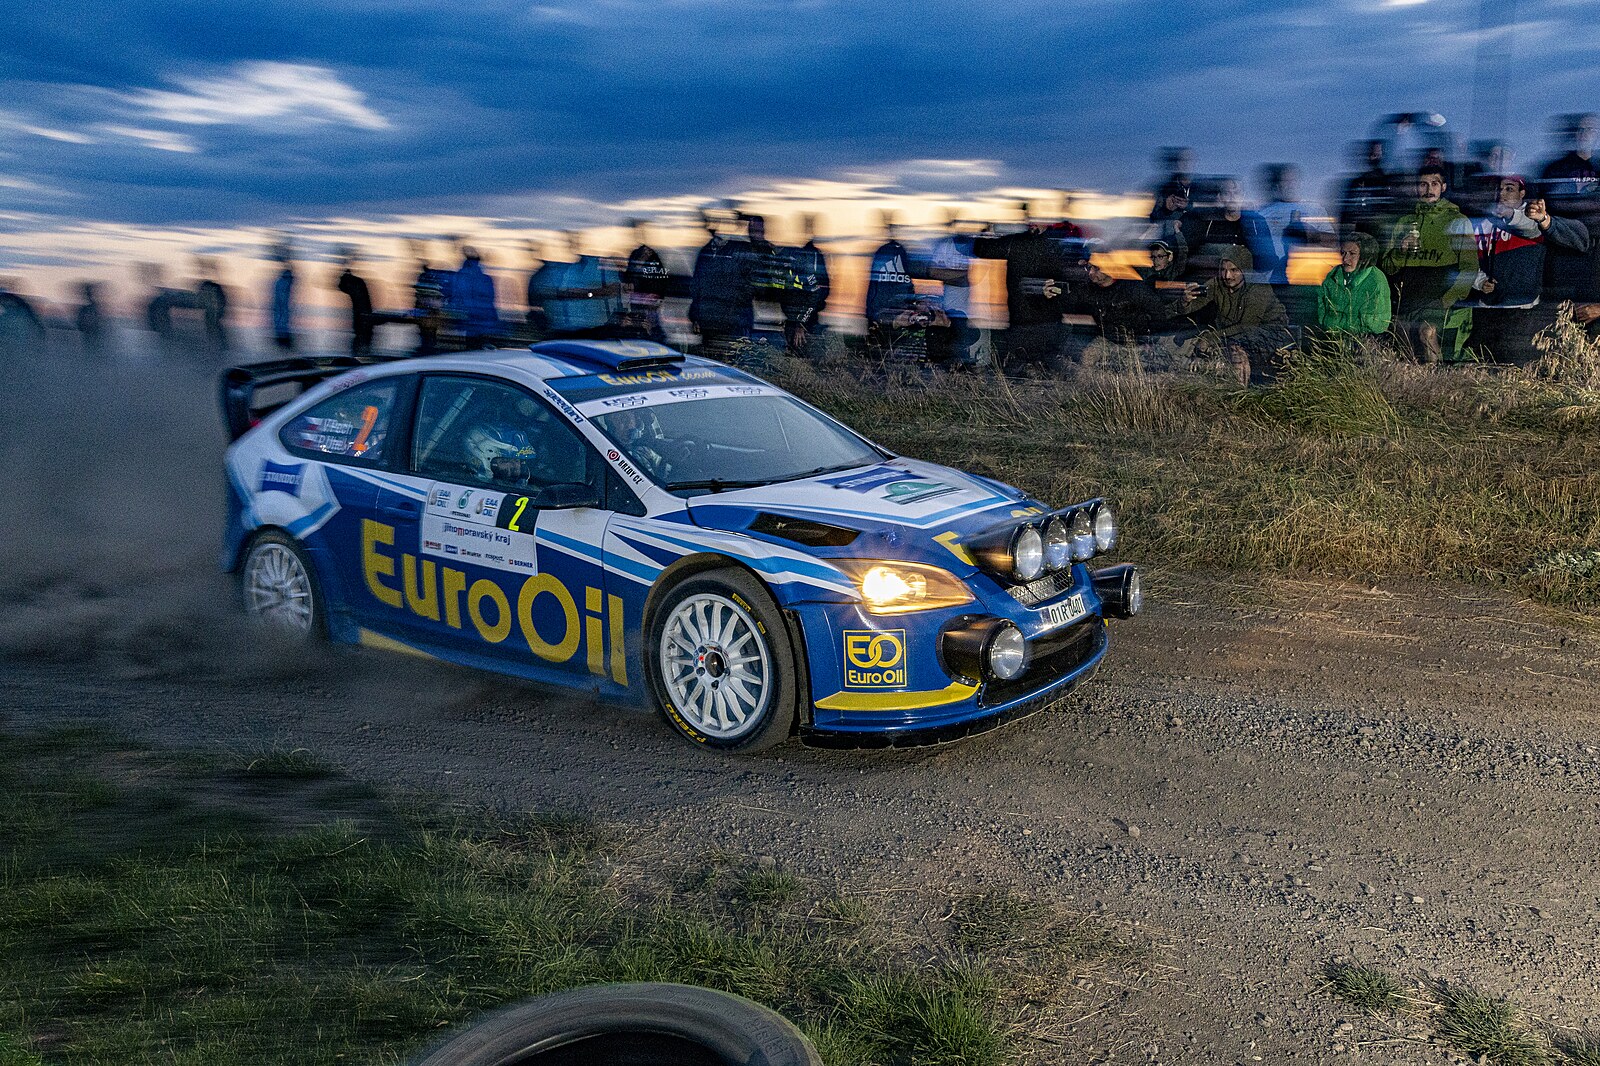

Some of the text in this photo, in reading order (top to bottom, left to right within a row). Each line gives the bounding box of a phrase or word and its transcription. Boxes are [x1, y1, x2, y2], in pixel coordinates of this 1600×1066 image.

[598, 370, 678, 386] EuroOil
[508, 496, 530, 532] 2
[443, 522, 511, 546] jihomoravský kraj
[514, 559, 534, 569] BERNER
[360, 518, 629, 687] EuroOil
[1050, 604, 1070, 624] 01R
[848, 669, 903, 684] EuroOil
